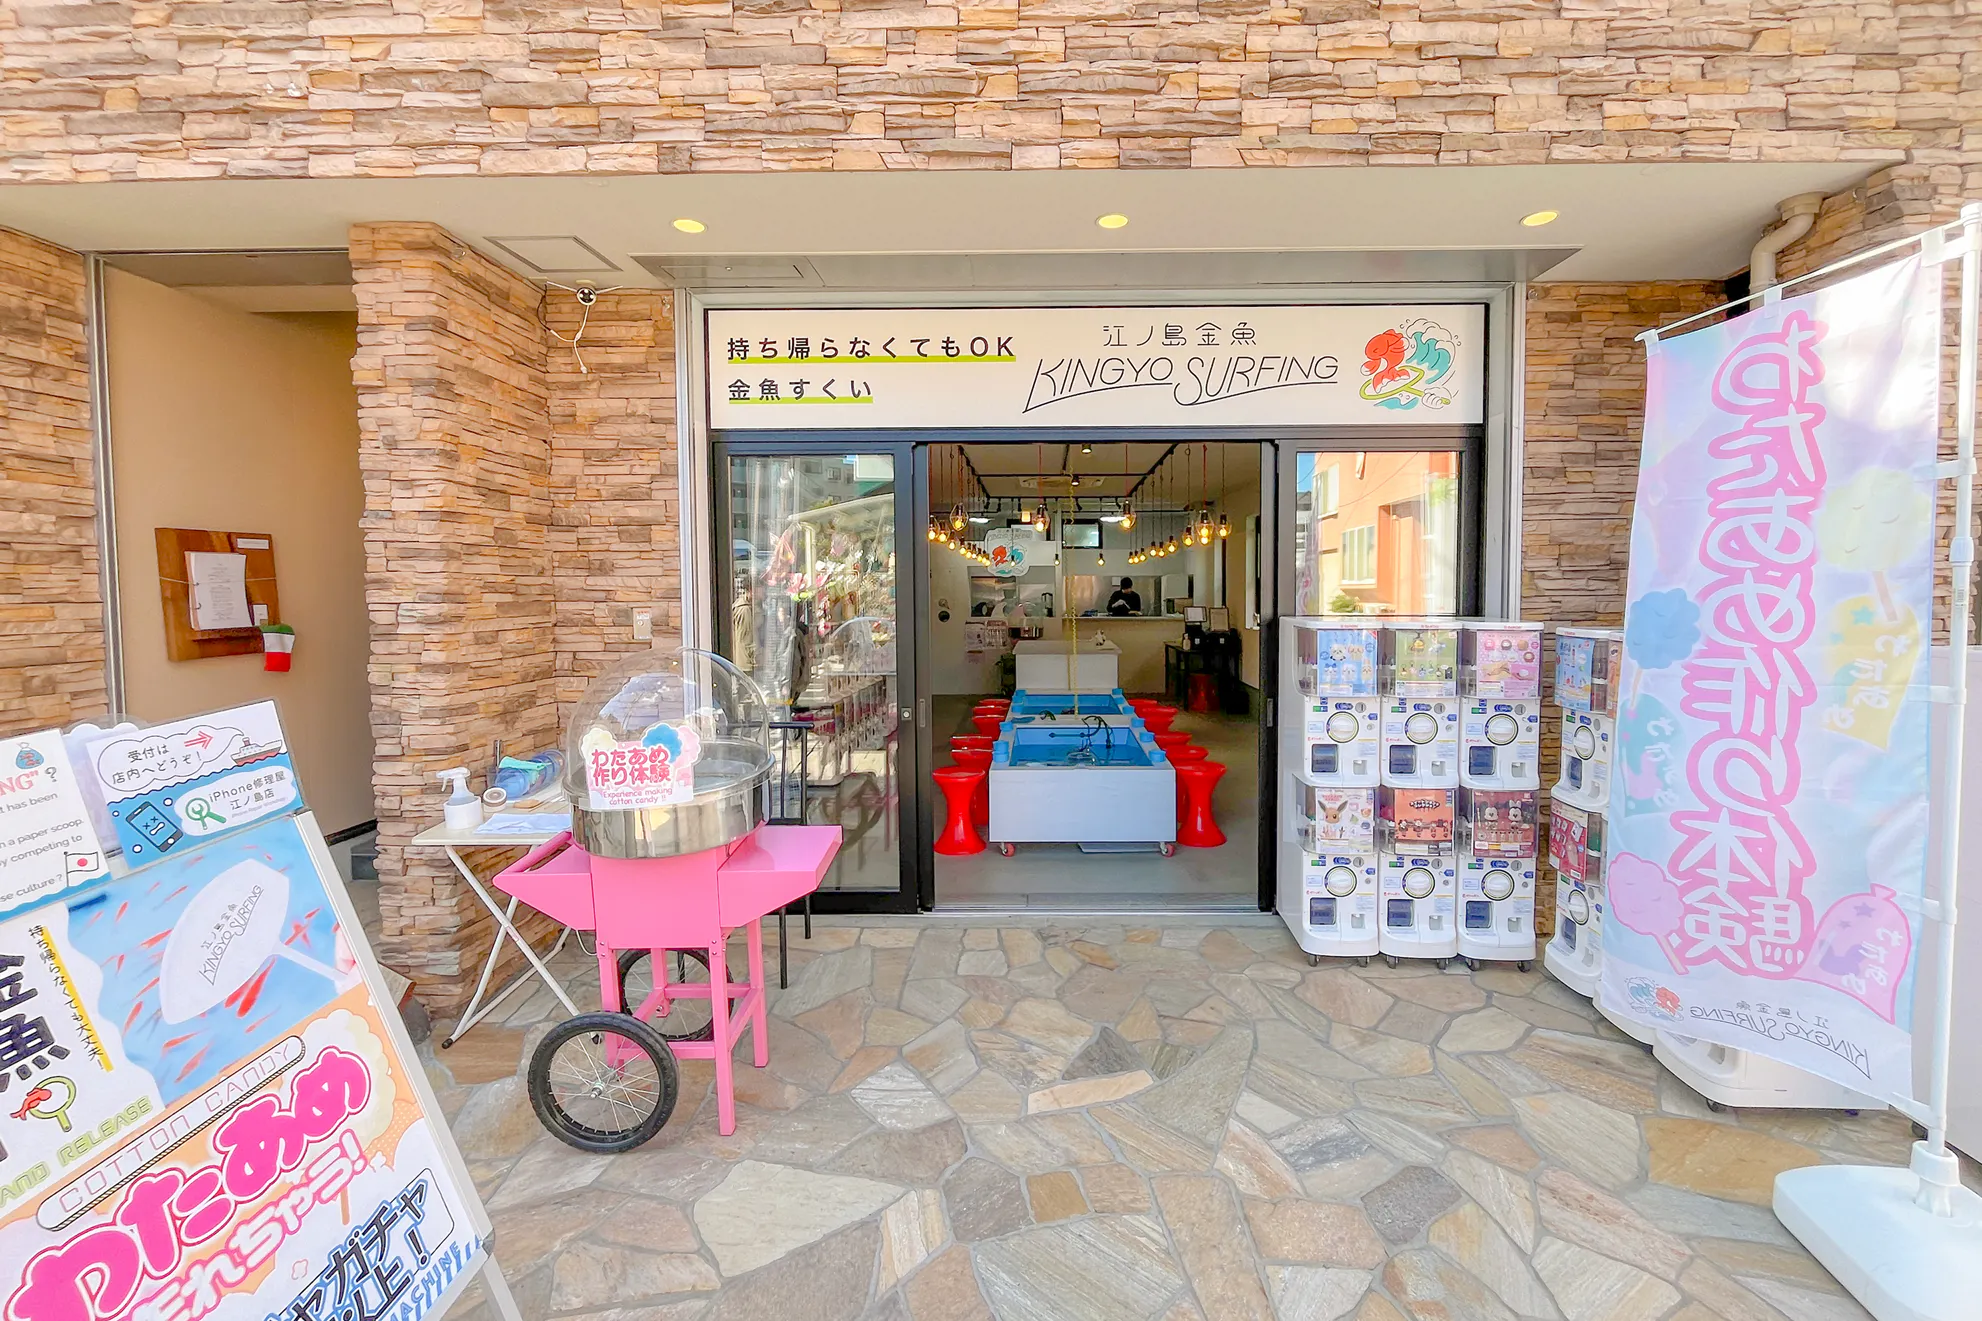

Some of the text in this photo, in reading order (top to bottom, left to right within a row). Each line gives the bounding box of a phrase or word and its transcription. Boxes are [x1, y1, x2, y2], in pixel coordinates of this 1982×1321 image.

[1103, 322, 1257, 346] 江ノ島金魚
[728, 336, 1014, 360] 持ち帰らなくてもOK
[728, 378, 872, 401] 金魚すくい
[1022, 356, 1338, 413] KINGYO SURFING
[127, 743, 171, 763] 受付は
[592, 745, 669, 767] わたあめ
[208, 770, 287, 803] iPhone修理屋
[593, 763, 671, 787] 作り体験
[8, 799, 34, 813] has
[36, 792, 58, 806] been
[230, 790, 275, 811] 江ノ島店
[604, 788, 673, 799] Experience making
[609, 797, 633, 806] cotton
[635, 795, 659, 805] candy
[18, 826, 48, 845] paper
[50, 818, 84, 837] scoop.
[11, 839, 67, 865] competing
[70, 833, 83, 846] to
[16, 877, 56, 898] culture
[199, 884, 264, 986] KINGYO SURFING
[57, 1095, 154, 1167] RELEASE
[60, 1042, 292, 1213] COTTON CANDY
[4, 1045, 371, 1321] わたあめ
